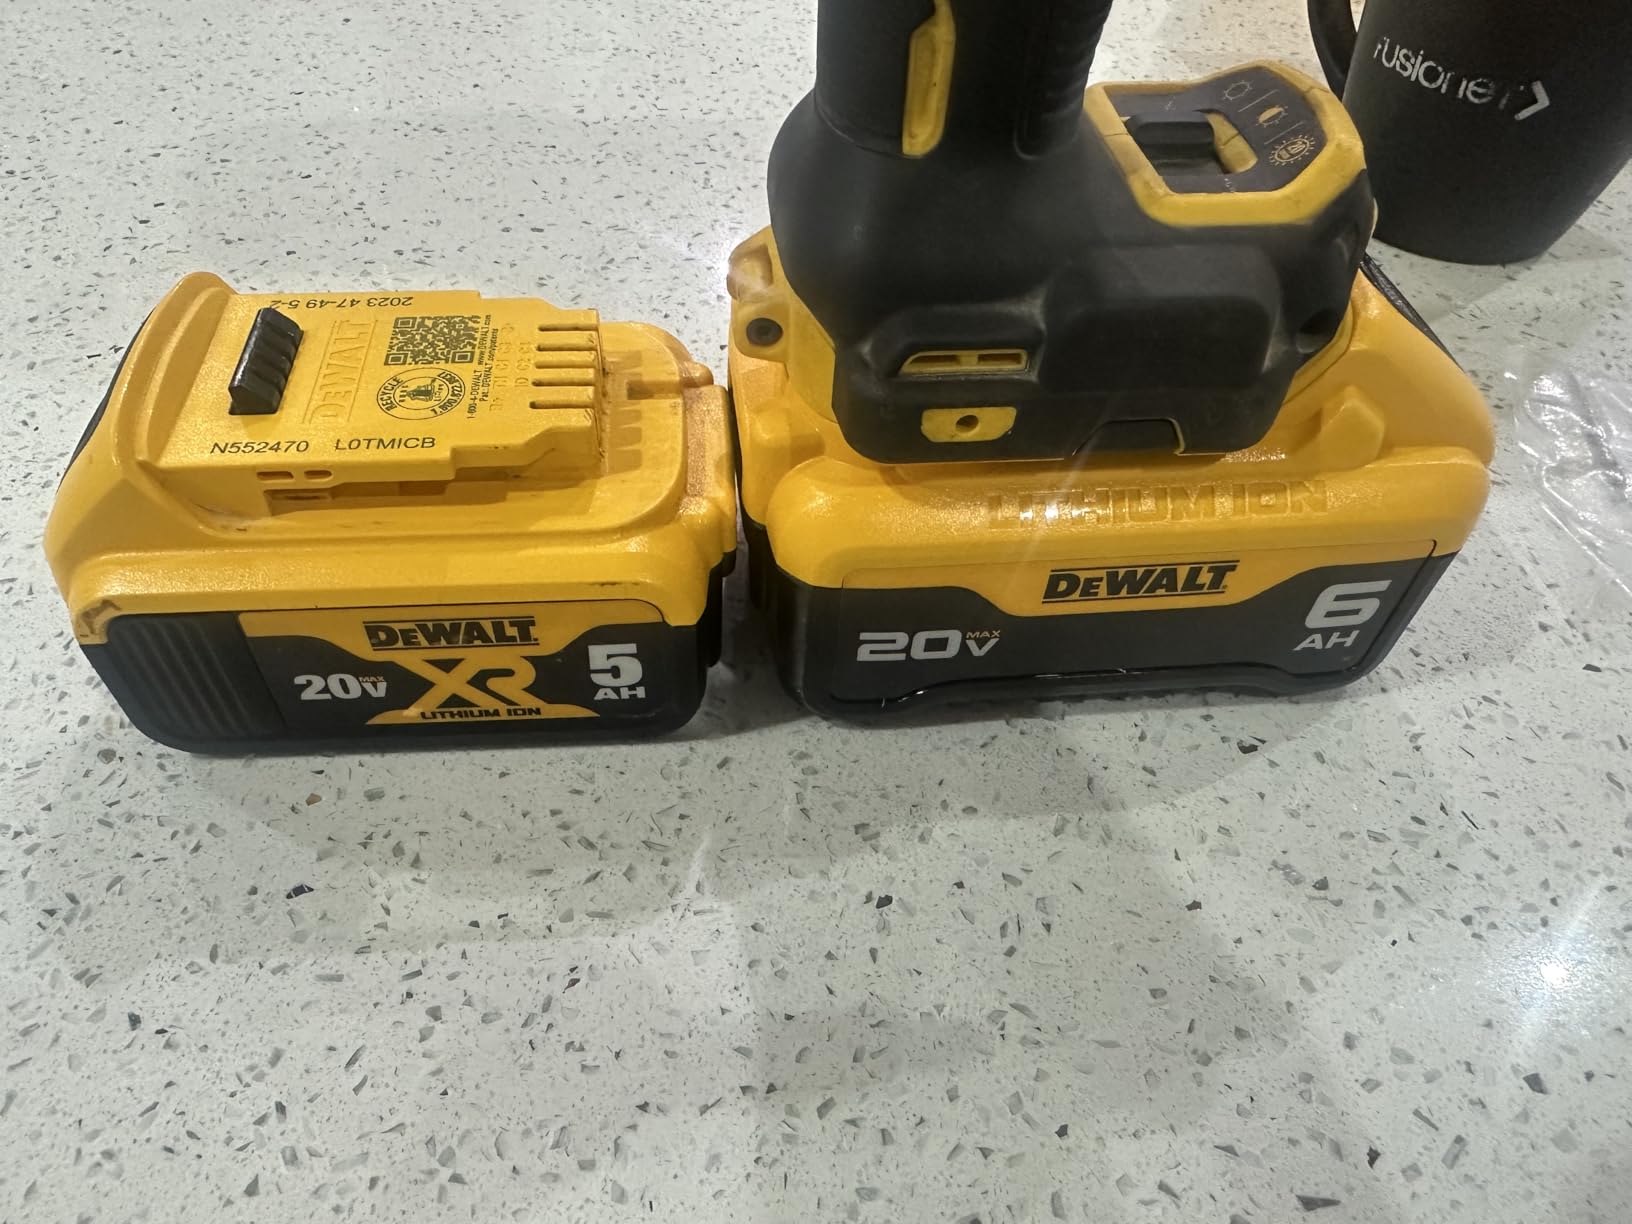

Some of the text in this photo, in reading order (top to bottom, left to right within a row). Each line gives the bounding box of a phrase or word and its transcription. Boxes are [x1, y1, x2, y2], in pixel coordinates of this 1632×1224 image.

[269, 296, 414, 310] 2023 47-49 5-2
[380, 376, 404, 412] RECYCLE
[210, 440, 309, 455] N552470
[987, 479, 1328, 531] LITHIUM ION
[1304, 579, 1392, 629] 6
[965, 630, 1001, 639] MAX
[1292, 629, 1361, 651] AH
[588, 643, 643, 687] 5
[392, 655, 549, 709] XR
[593, 686, 646, 701] AH
[420, 706, 542, 720] LITHIUM ION
